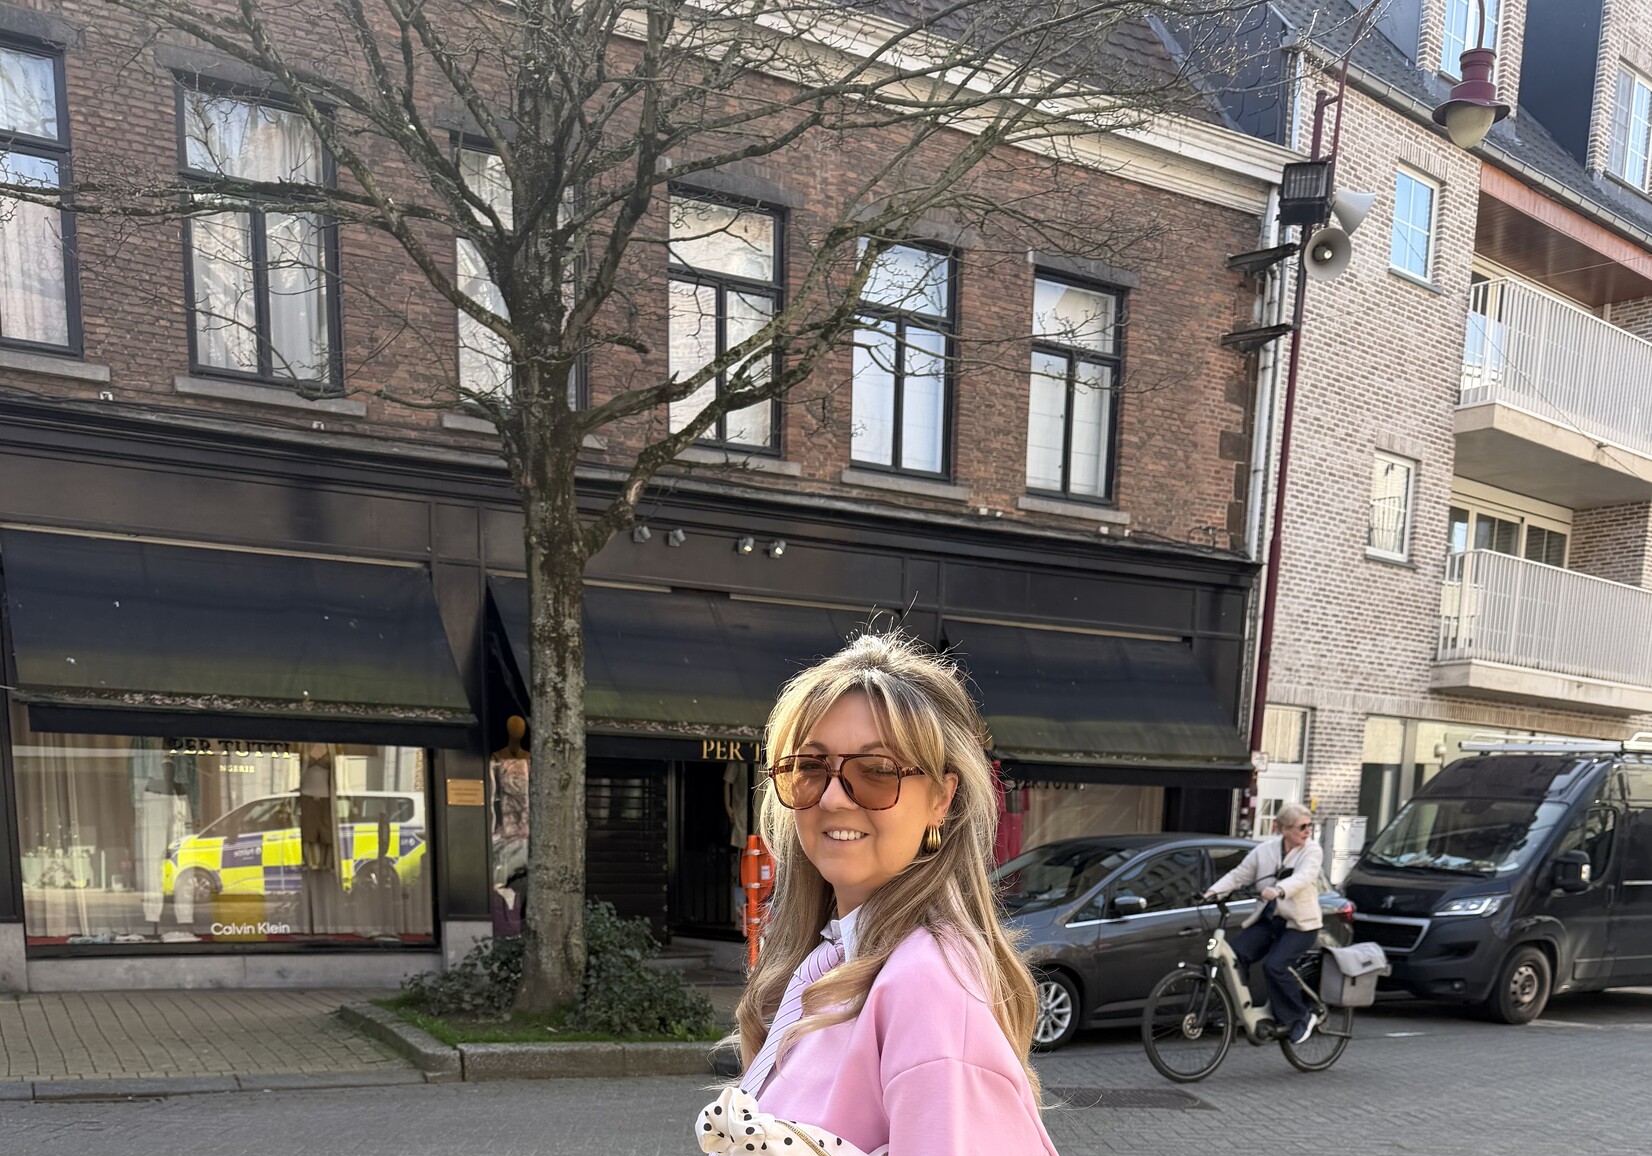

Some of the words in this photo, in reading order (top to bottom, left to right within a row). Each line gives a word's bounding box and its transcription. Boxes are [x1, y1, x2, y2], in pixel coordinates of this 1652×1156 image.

[168, 739, 214, 756] PER
[218, 740, 291, 759] TUTTI
[702, 740, 745, 761] PER
[210, 922, 256, 936] Calvin
[257, 921, 291, 935] Klein
